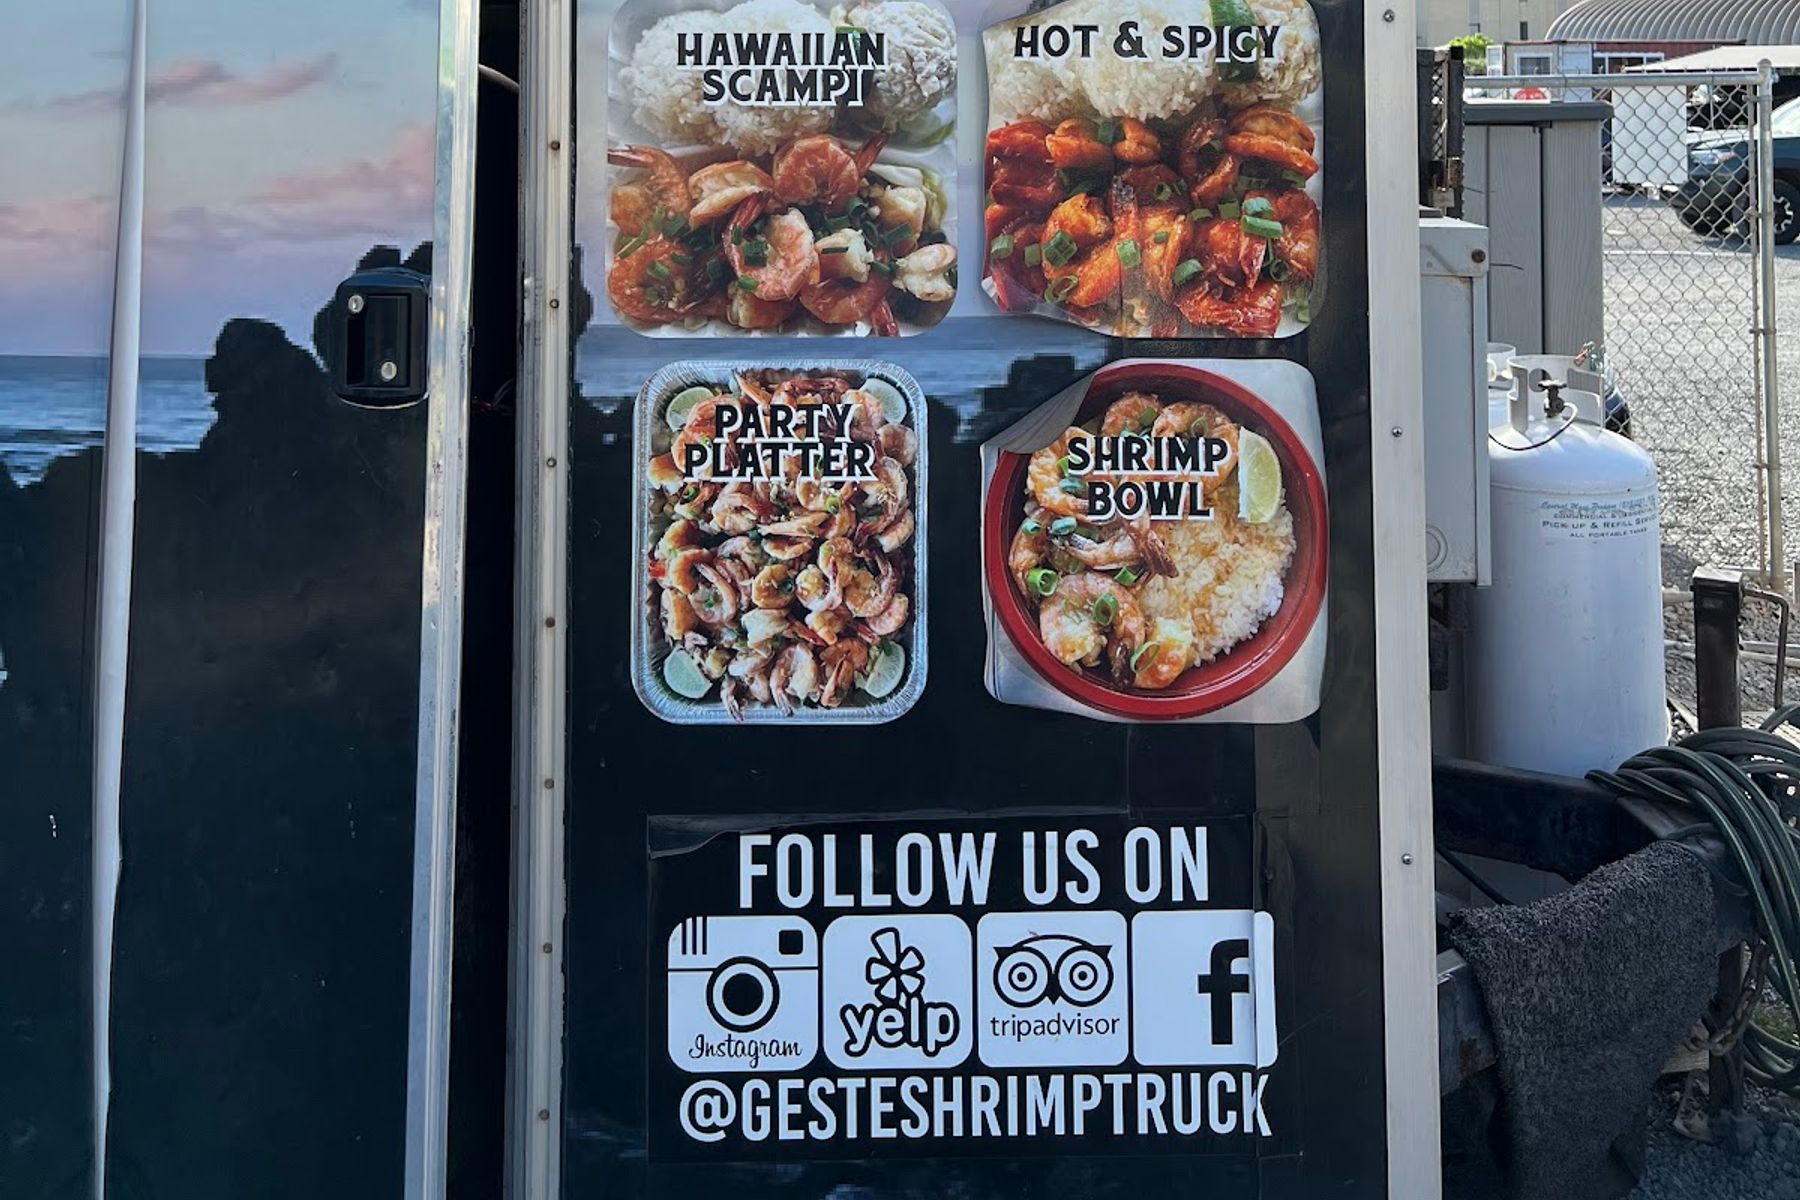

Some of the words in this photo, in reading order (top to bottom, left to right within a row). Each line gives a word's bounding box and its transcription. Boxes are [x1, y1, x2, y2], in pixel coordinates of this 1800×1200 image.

[677, 32, 887, 69] HAWAIIAN
[1014, 23, 1099, 59] HOT
[1113, 21, 1147, 59] &
[1162, 23, 1282, 62] SPICY
[703, 68, 866, 107] SCAMPI
[714, 403, 860, 444] PARTY
[684, 442, 877, 483] PLATTER
[1065, 435, 1233, 477] SHRIMP
[1085, 480, 1214, 522] BOWL
[739, 832, 996, 909] FOLLOW
[1023, 828, 1099, 905] US
[1124, 826, 1209, 904] ON
[839, 996, 961, 1058] yelp
[990, 1013, 1121, 1043] tripadvisor
[688, 1034, 803, 1069] Instagram
[679, 1071, 1273, 1143] @GESTESHRIMPTRUCK
